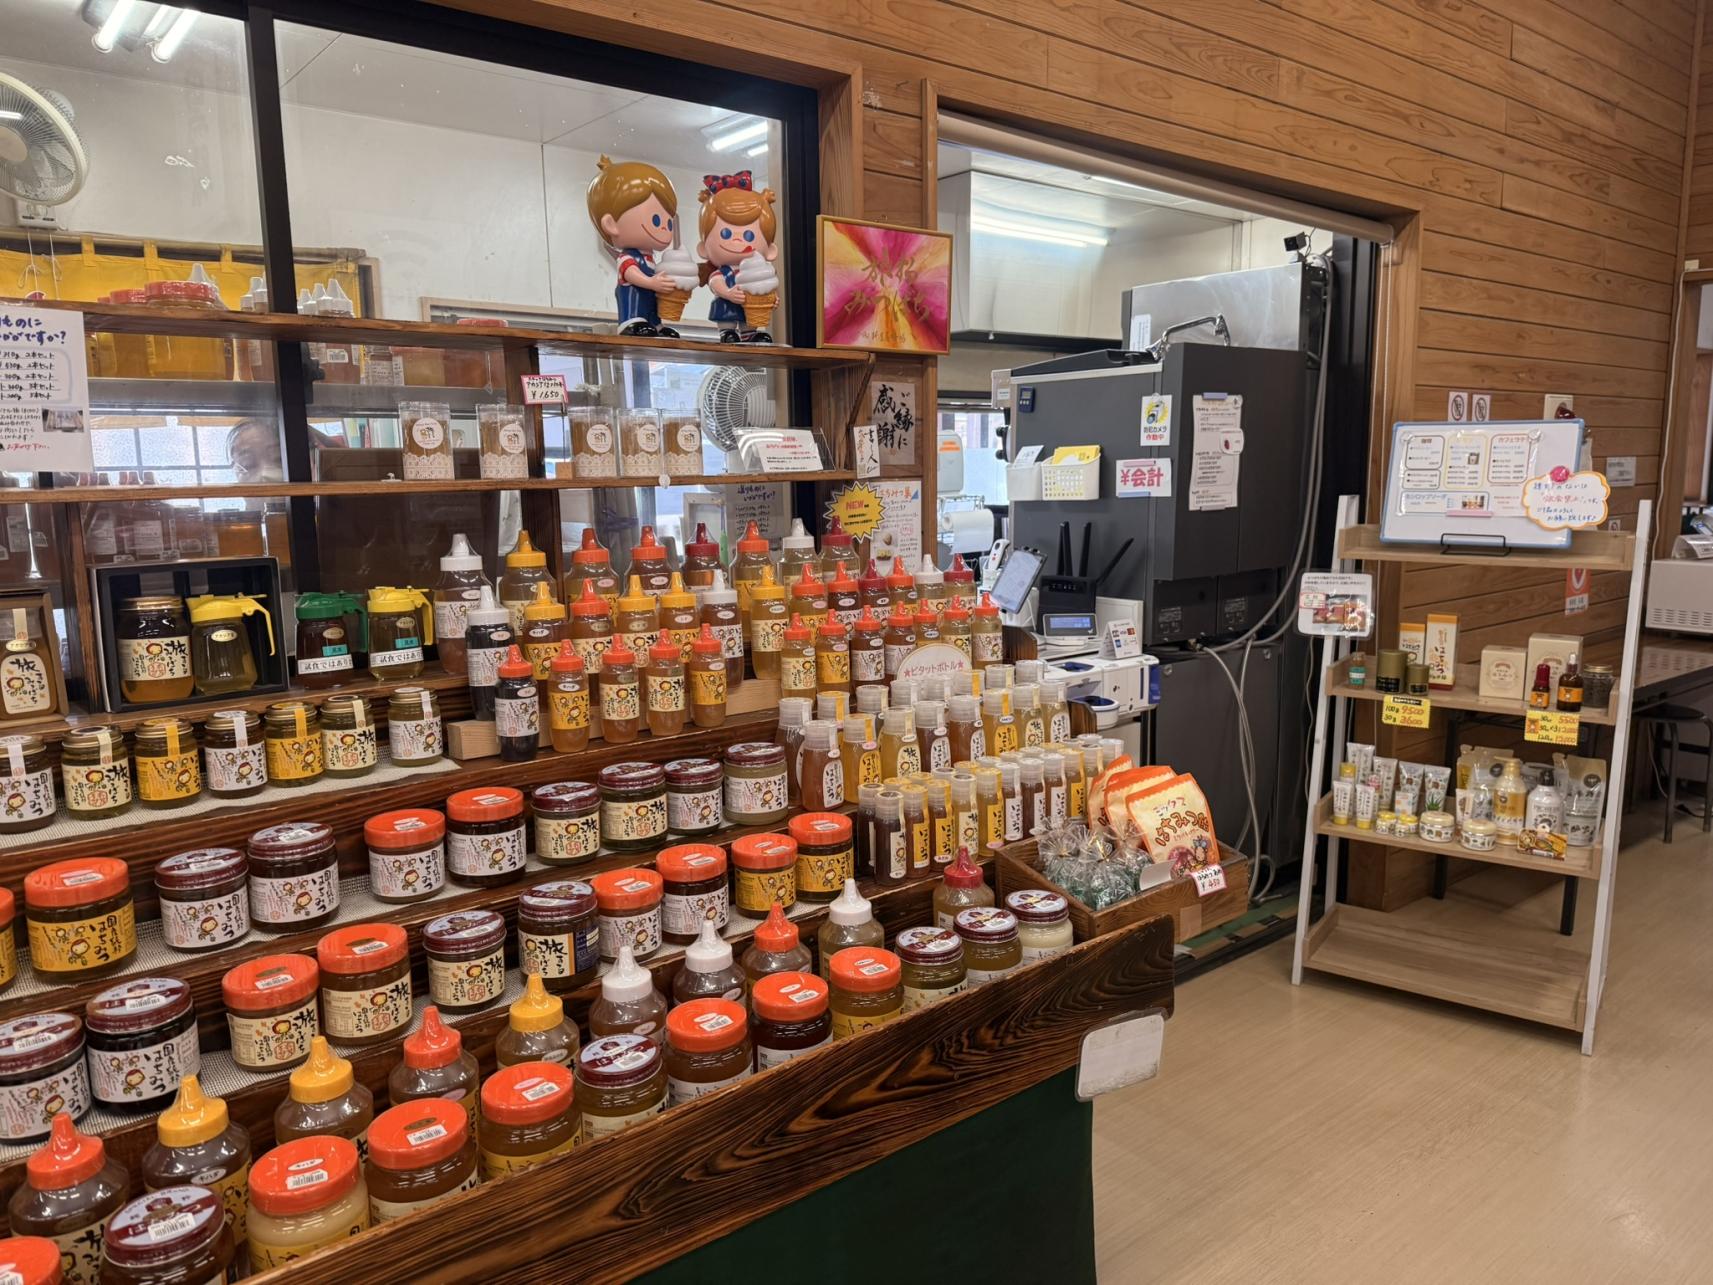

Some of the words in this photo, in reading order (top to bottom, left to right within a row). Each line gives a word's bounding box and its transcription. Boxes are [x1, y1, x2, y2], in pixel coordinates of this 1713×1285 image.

[0, 315, 42, 329] ものに
[0, 330, 66, 345] かがですか?
[873, 384, 897, 448] 感謝
[846, 501, 864, 510] NEW
[89, 921, 110, 962] はちみつ
[144, 1049, 167, 1093] はちみつ
